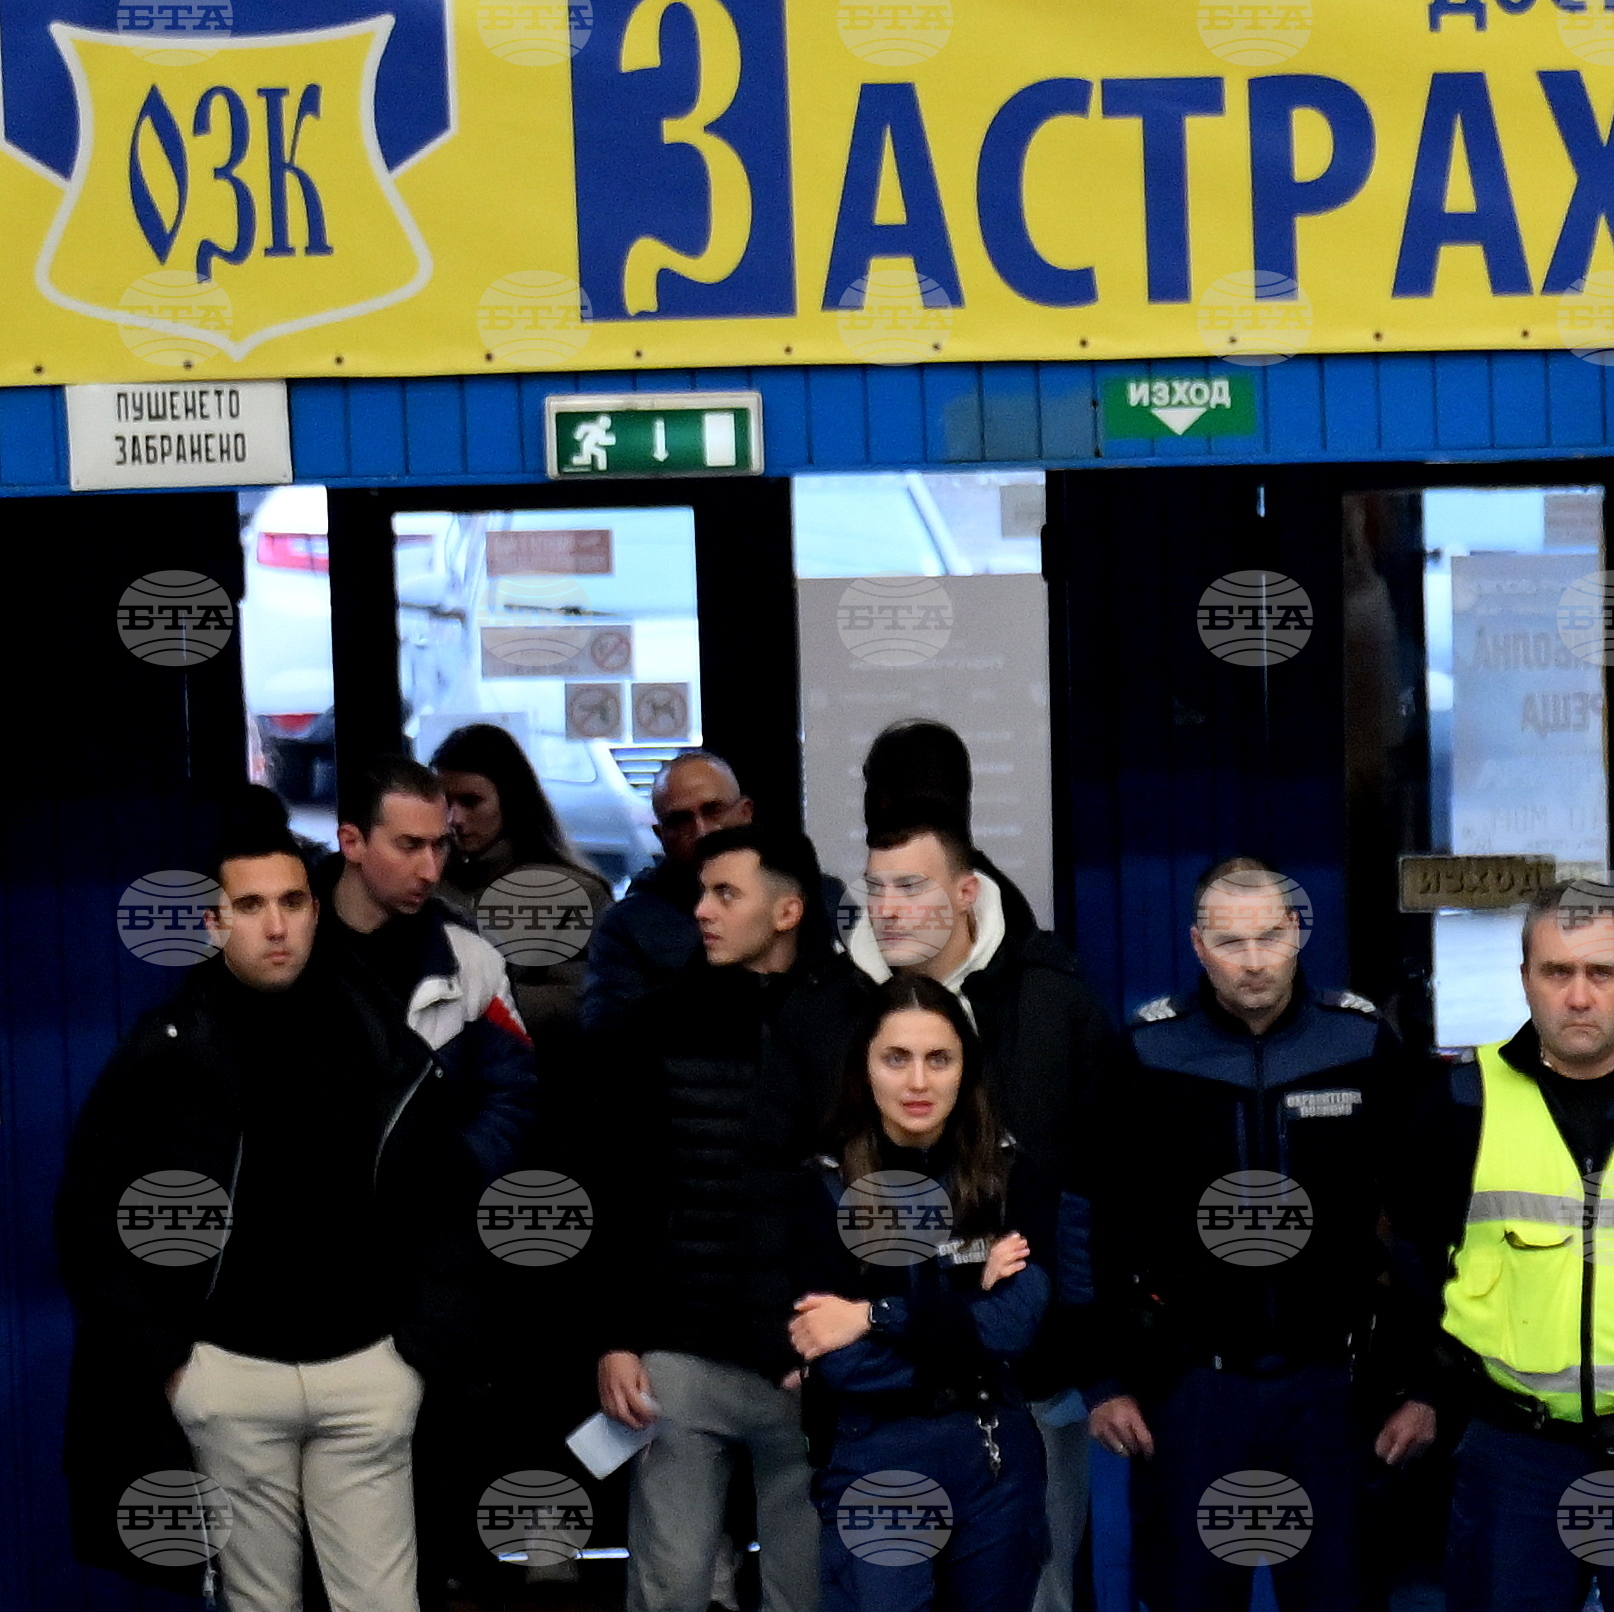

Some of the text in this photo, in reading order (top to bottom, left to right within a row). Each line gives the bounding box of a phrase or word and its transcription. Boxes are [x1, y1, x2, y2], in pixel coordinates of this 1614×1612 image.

[129, 82, 334, 283] ОЗК
[116, 389, 242, 426] ПУШЕНЕТО
[1128, 380, 1231, 409] ИЗХОД
[115, 433, 248, 467] ЗАБРАНЕНО
